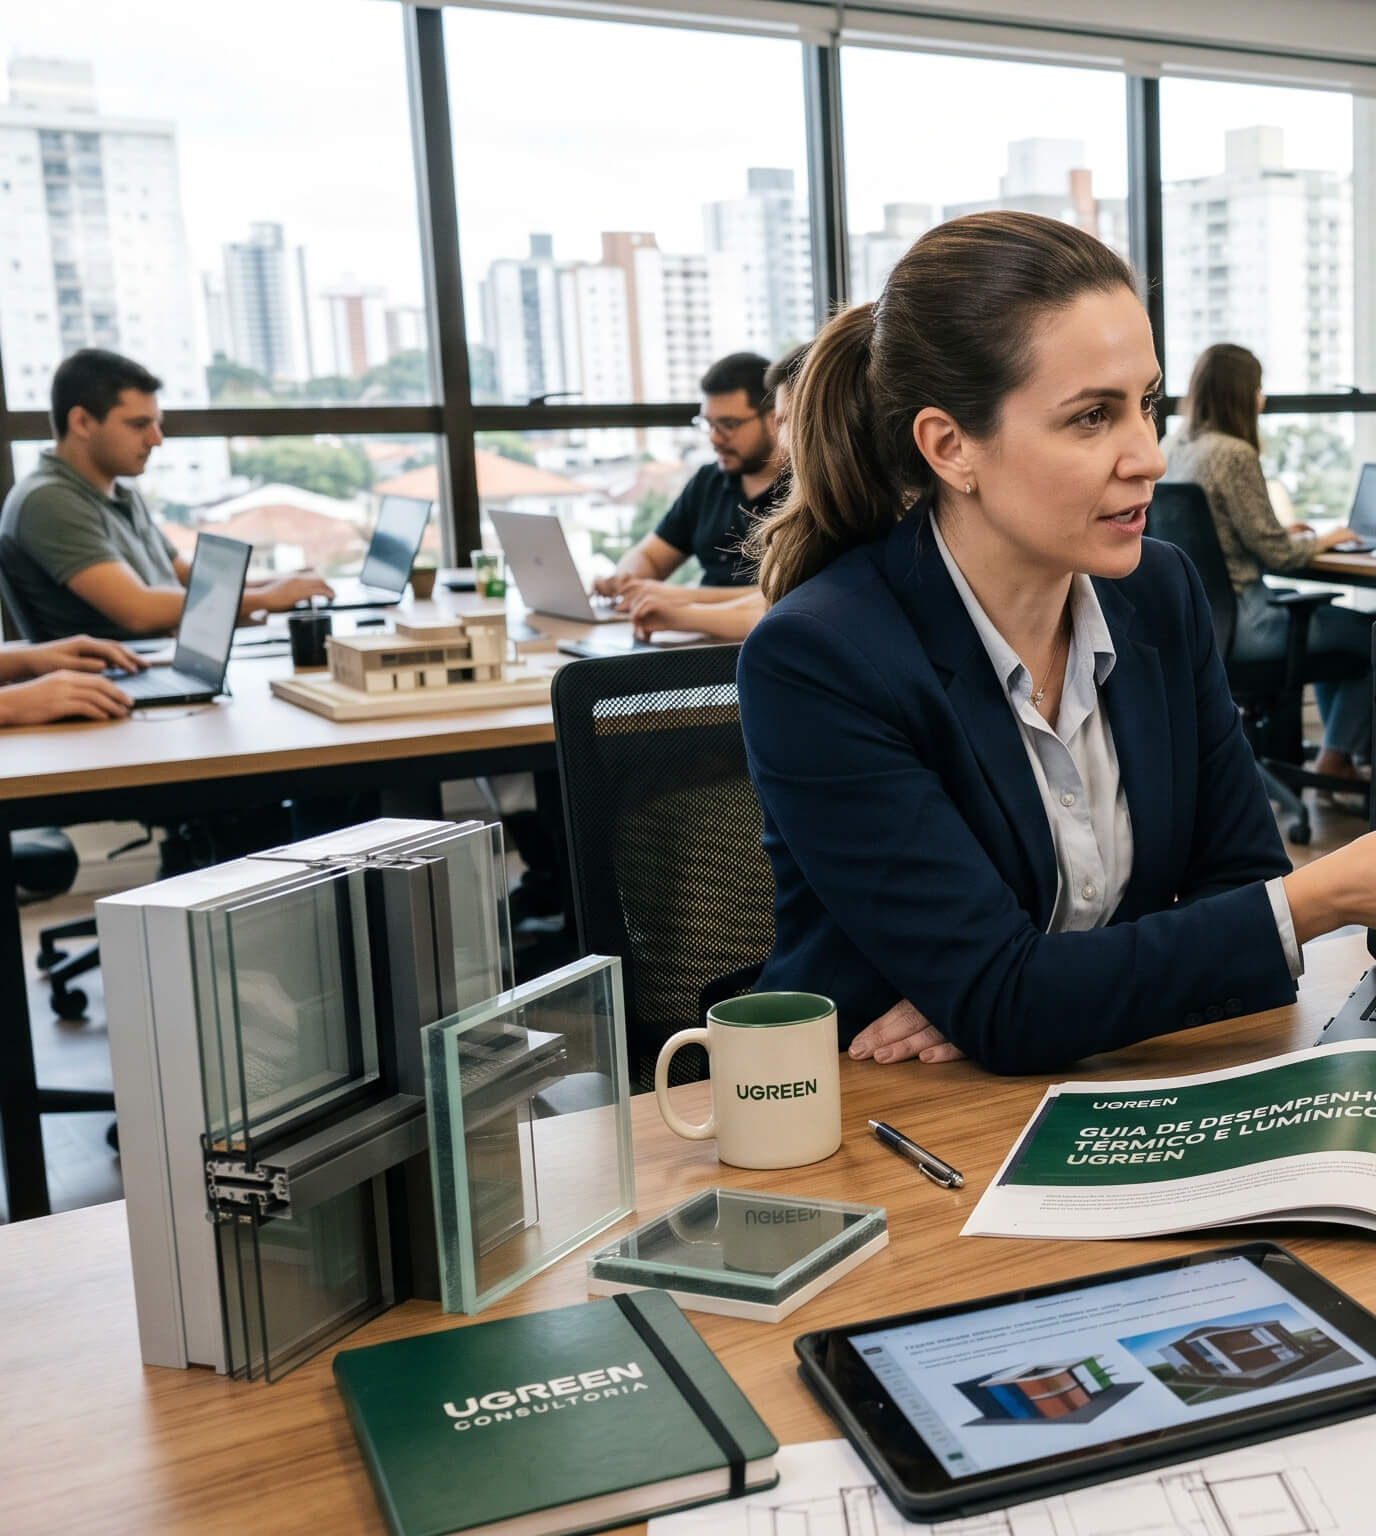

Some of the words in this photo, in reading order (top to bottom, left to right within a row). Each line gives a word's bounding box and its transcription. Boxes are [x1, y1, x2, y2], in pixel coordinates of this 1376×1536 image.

[736, 1078, 817, 1101] UGREEN
[1092, 1097, 1178, 1110] UGREEN
[1073, 1127, 1207, 1152] TÉRMICO
[1213, 1128, 1231, 1141] E
[1079, 1126, 1147, 1138] GUIA
[1155, 1121, 1194, 1135] DE
[1066, 1149, 1186, 1166] UGREEN
[442, 1361, 645, 1419] UGREEN
[453, 1382, 650, 1432] CONSULTORIA
